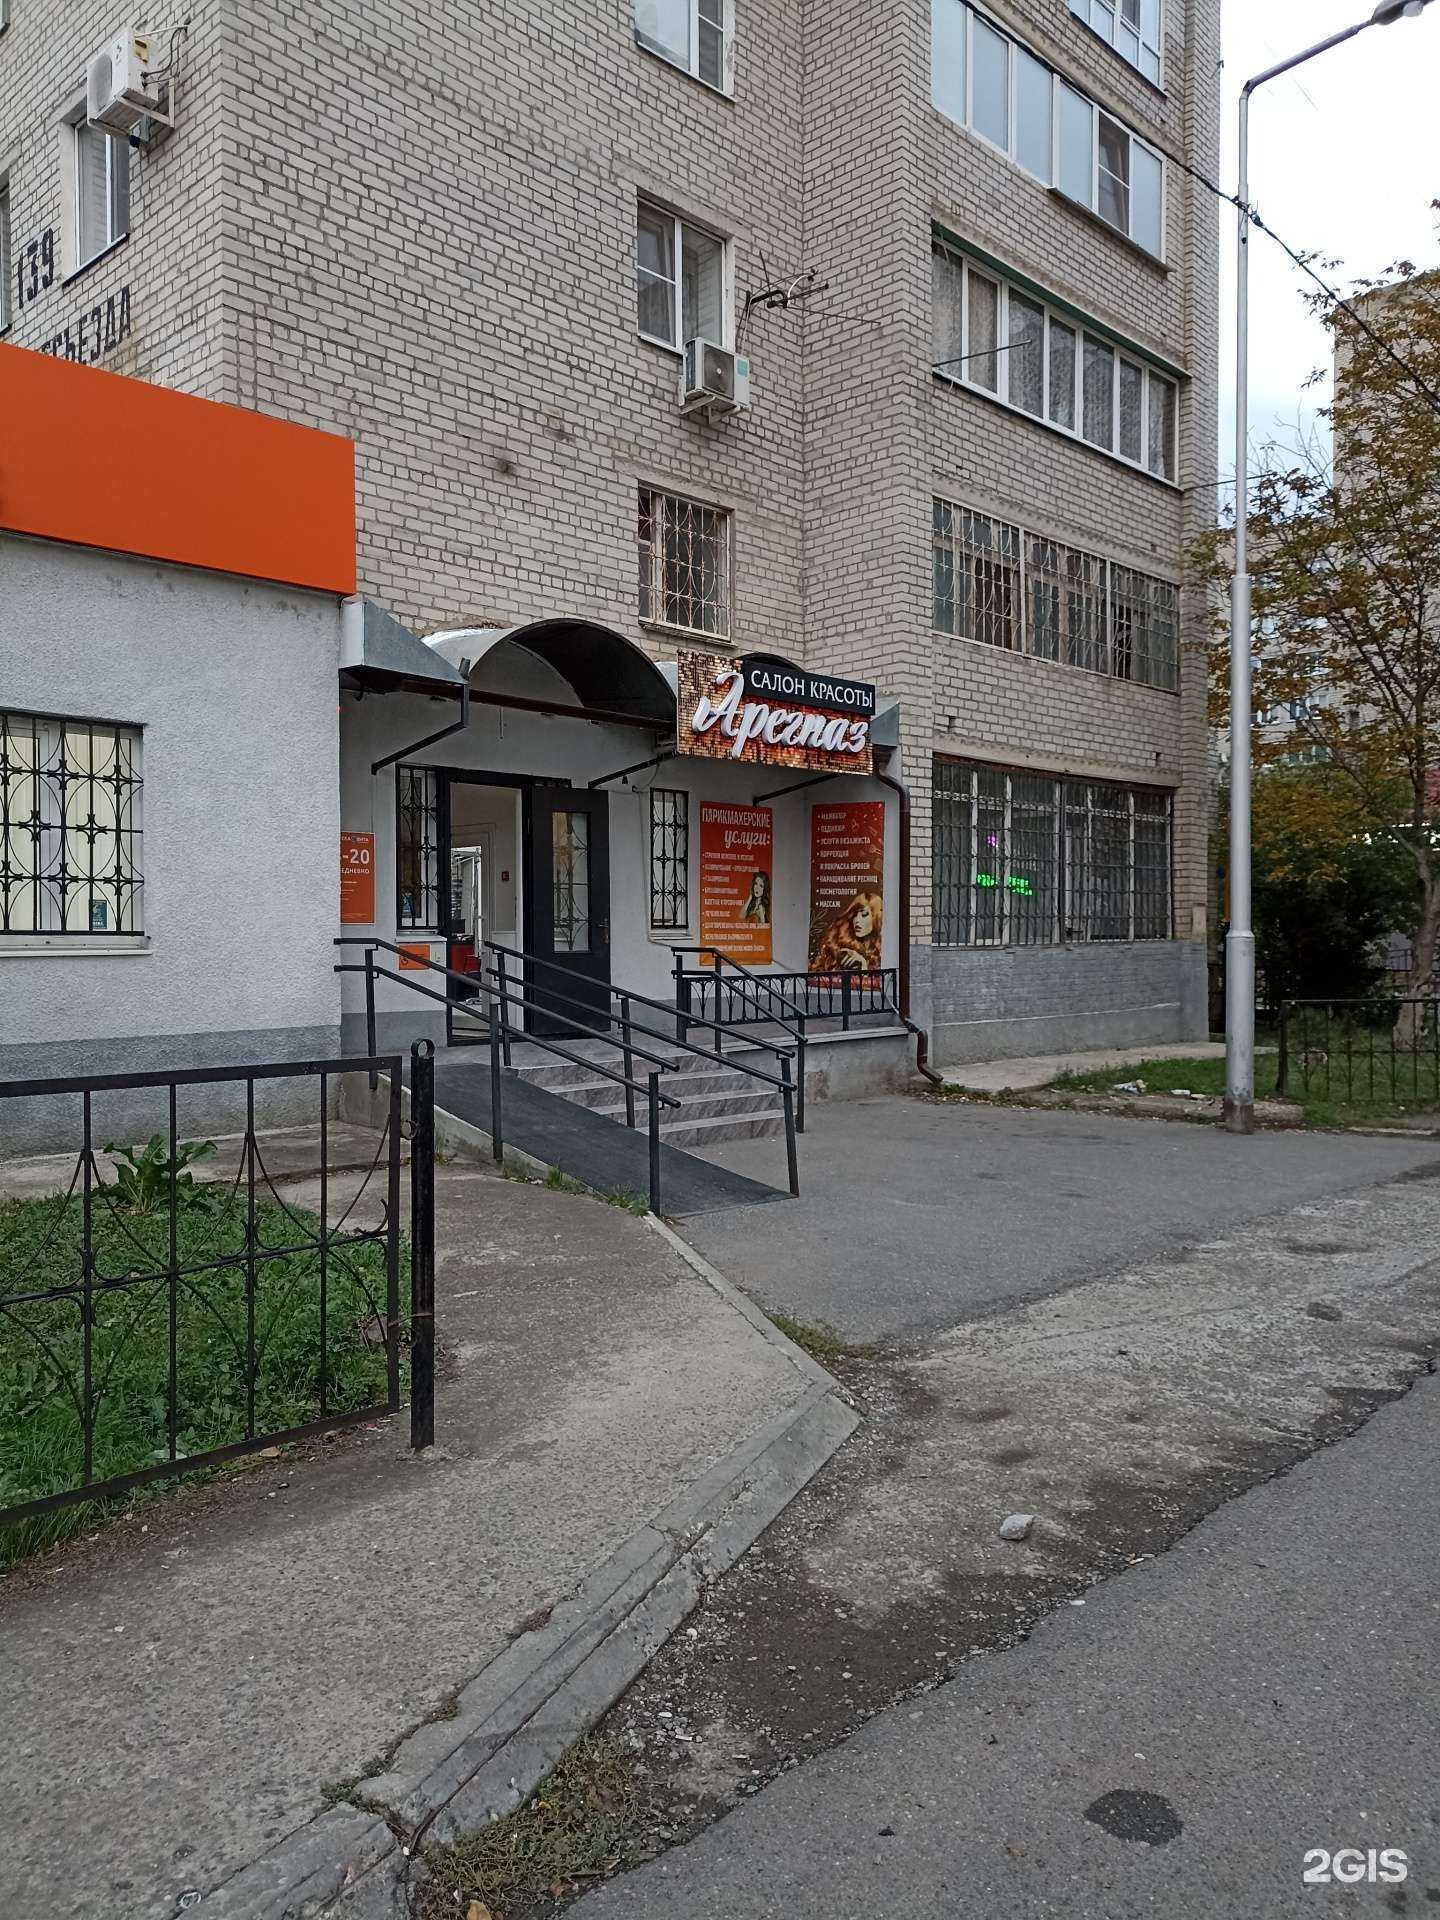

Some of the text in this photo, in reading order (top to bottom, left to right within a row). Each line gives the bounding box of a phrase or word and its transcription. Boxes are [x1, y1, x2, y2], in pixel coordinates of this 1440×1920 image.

[18, 228, 54, 309] 139
[750, 670, 873, 708] САЛОН КРАСОТЫ
[691, 671, 869, 759] Арегназ
[702, 807, 771, 828] ПАРИКМАХЕРСКИЕ
[724, 830, 771, 849] услуги:
